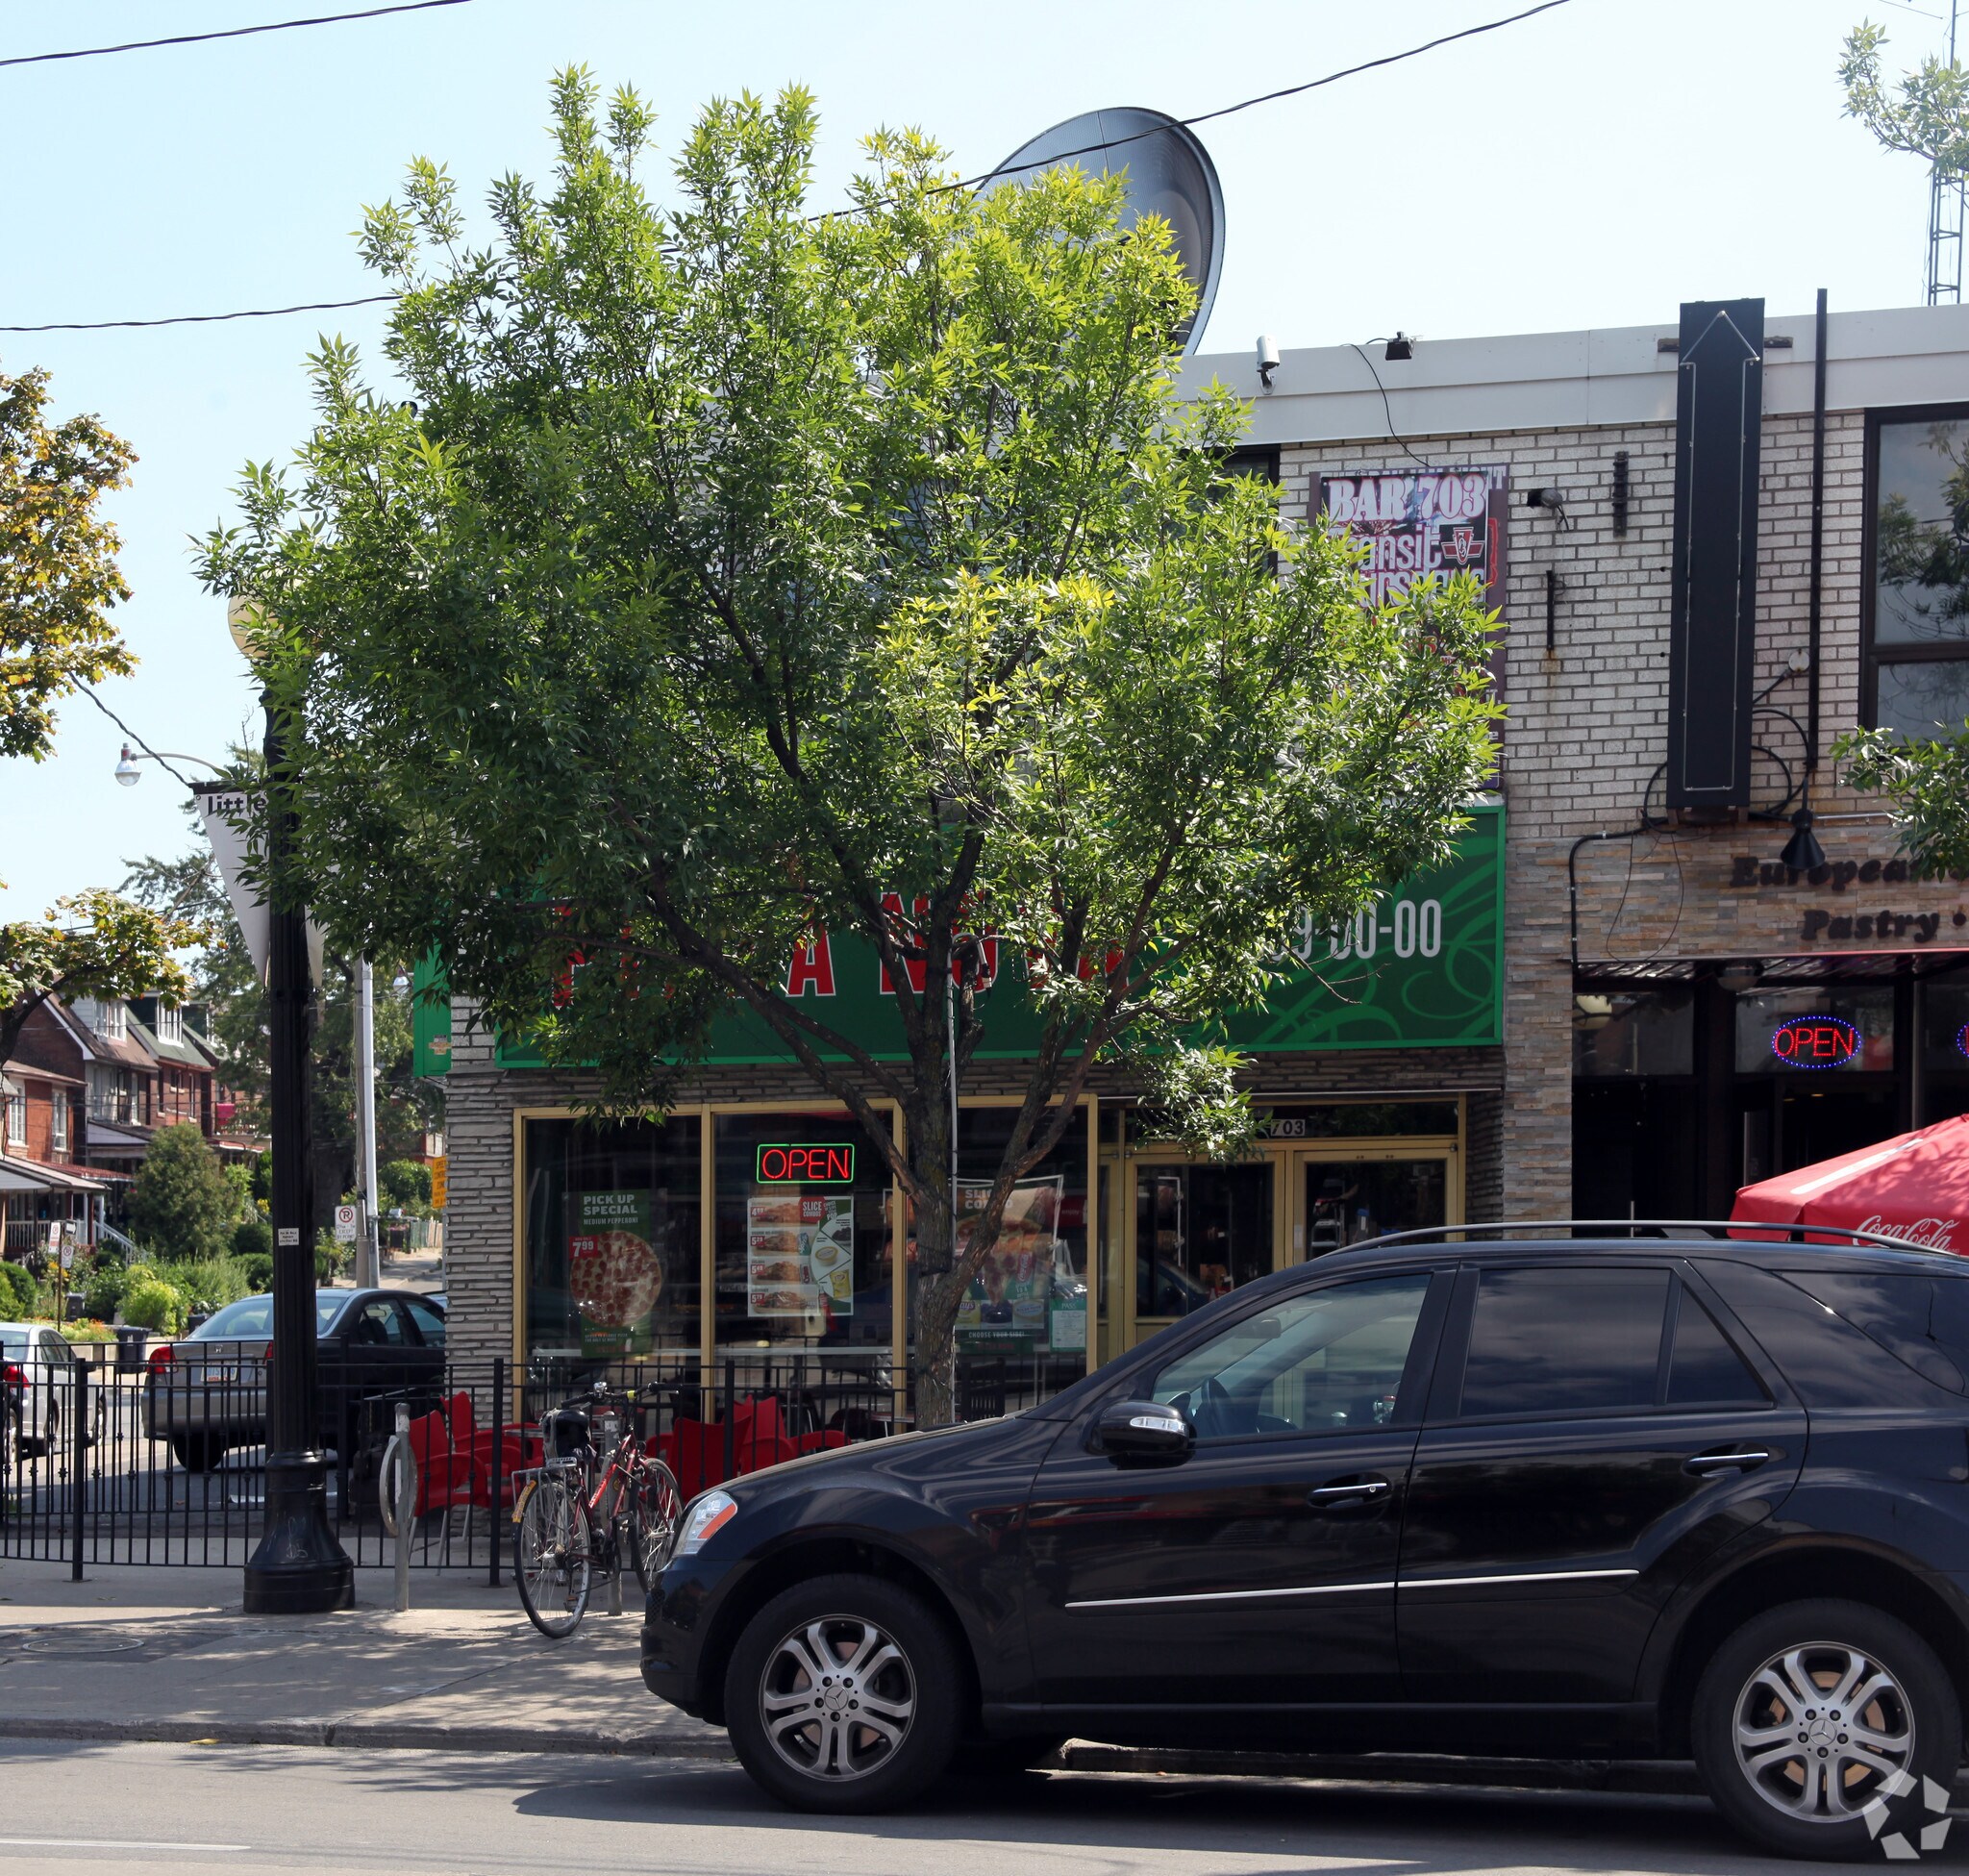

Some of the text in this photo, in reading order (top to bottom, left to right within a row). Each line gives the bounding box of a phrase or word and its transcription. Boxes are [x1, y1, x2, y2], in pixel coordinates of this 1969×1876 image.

[1328, 476, 1408, 522] BAR
[1417, 474, 1487, 520] 703
[1325, 522, 1440, 571] ansit
[1730, 856, 1925, 891] Europea
[1271, 898, 1442, 962] 9-00-00
[1801, 910, 1940, 943] Pastry
[1774, 1027, 1855, 1058] OPEN
[1271, 1119, 1305, 1135] 703
[761, 1148, 850, 1179] OPEN
[584, 1194, 635, 1205] PICK UP
[964, 1188, 993, 1198] SLI
[964, 1199, 1013, 1209] COO
[584, 1205, 637, 1215] SPECIAL
[802, 1201, 822, 1212] SLICE
[607, 1216, 638, 1225] PEPPERONI
[1853, 1214, 1961, 1249] Coca-Cola
[960, 1302, 975, 1311] ays
